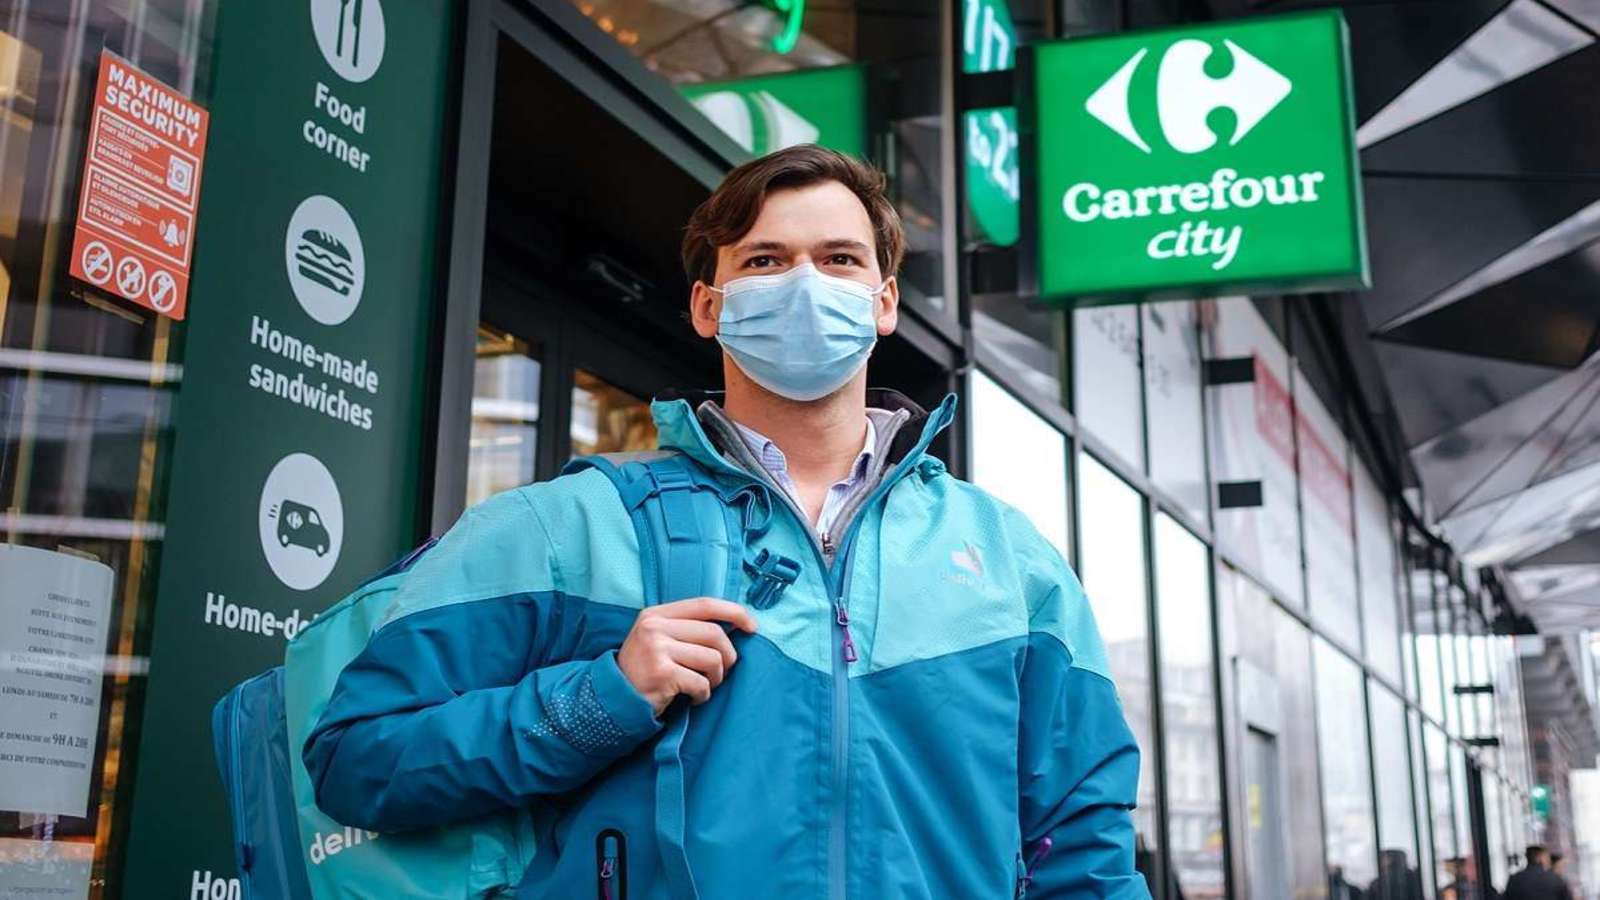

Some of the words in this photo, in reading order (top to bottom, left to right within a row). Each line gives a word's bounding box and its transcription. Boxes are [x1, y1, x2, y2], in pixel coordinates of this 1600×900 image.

[105, 85, 199, 148] SECURITY
[109, 64, 200, 129] MAXIMUM
[315, 82, 366, 134] Food
[303, 120, 371, 172] corner
[1062, 168, 1325, 222] Carrefour
[1147, 220, 1242, 270] city
[251, 315, 379, 394] Home-made
[249, 363, 373, 430] sandwiches
